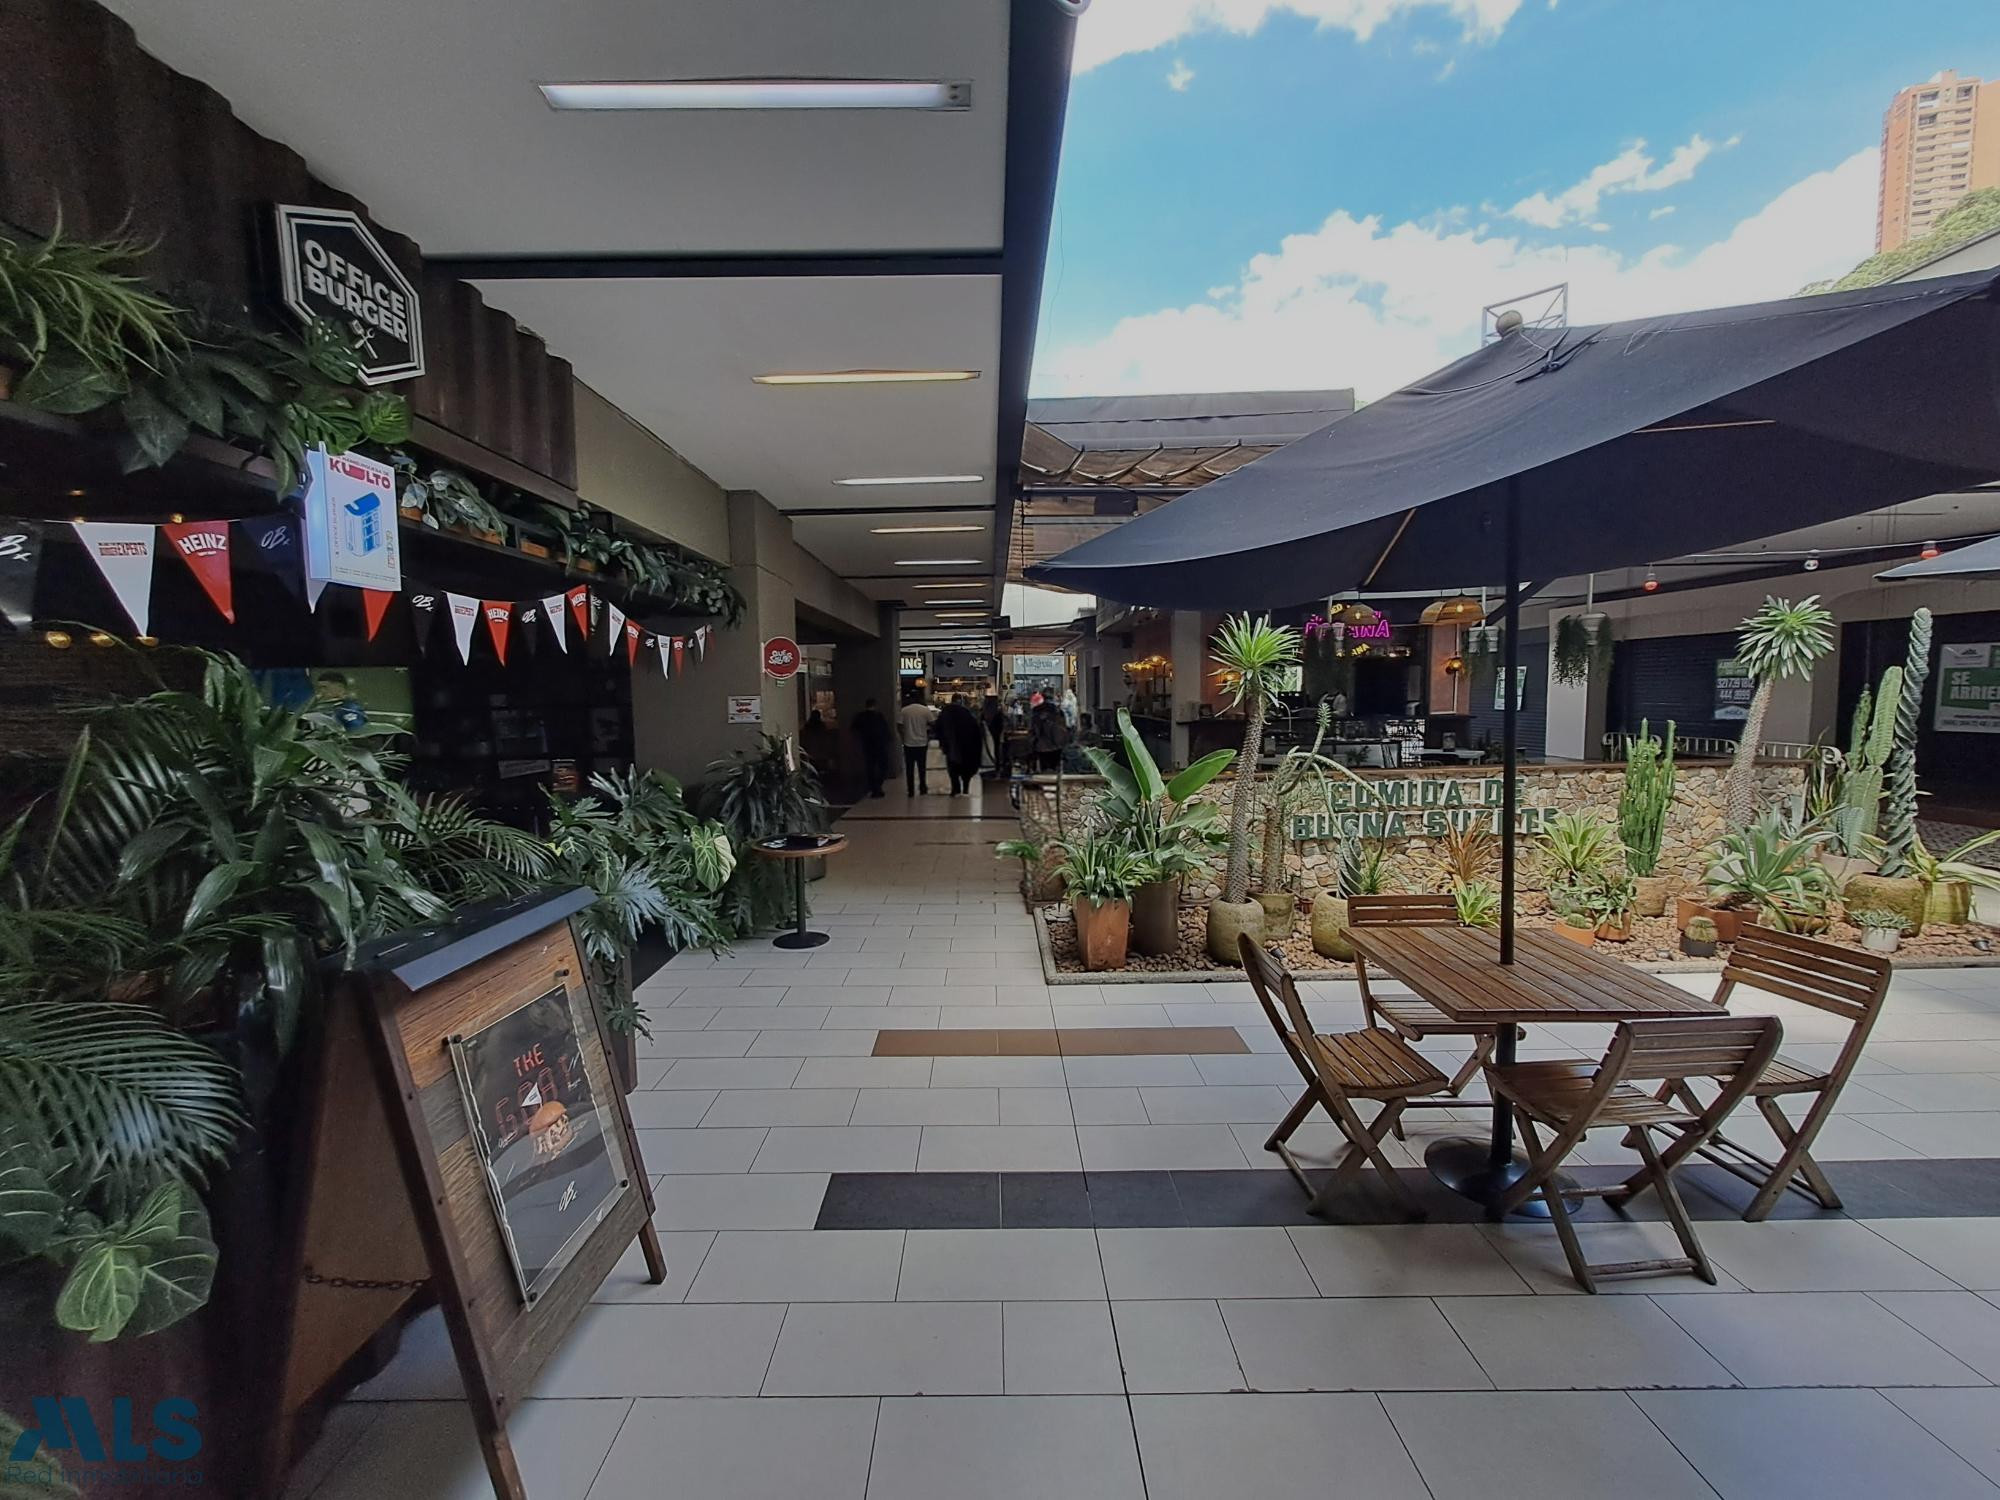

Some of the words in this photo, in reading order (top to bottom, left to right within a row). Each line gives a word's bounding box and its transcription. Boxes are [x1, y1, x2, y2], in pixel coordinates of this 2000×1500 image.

[304, 239, 406, 319] OFFICE
[305, 263, 408, 343] BURGER
[0, 534, 28, 556] B
[177, 532, 227, 555] HEINZ
[900, 657, 922, 669] ING
[1951, 671, 1971, 686] SE
[1328, 780, 1463, 809] COMIDA
[512, 1042, 545, 1078] THE
